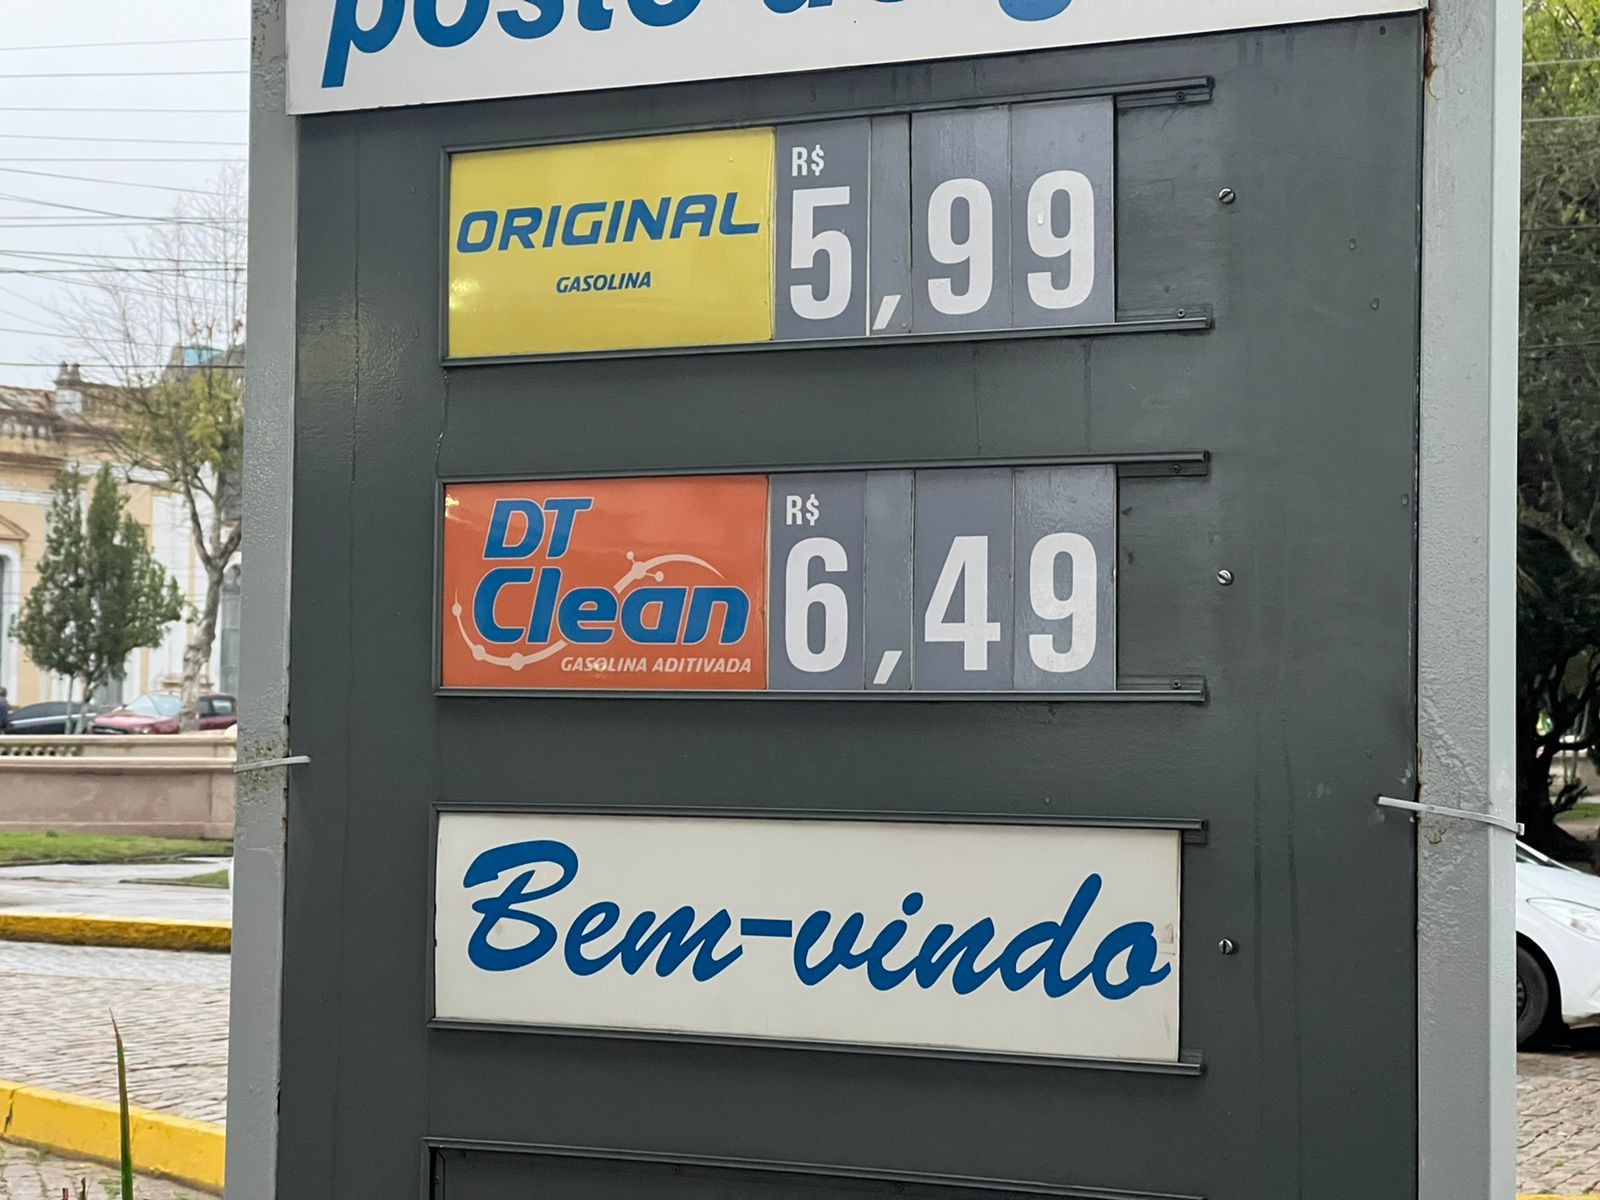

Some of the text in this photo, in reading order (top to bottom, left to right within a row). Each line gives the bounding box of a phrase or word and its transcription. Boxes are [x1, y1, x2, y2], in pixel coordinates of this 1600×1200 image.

[791, 144, 825, 177] R$
[457, 192, 760, 253] ORIGINAL
[789, 169, 1096, 330] 5,99
[555, 271, 652, 295] GASOLINA
[483, 497, 595, 560] DT
[785, 494, 820, 526] R$
[473, 566, 751, 646] Clean
[784, 532, 1098, 685] 6,49
[560, 656, 752, 674] GASOLINA ADITIVADA
[462, 839, 1173, 1001] Bem-vindo
